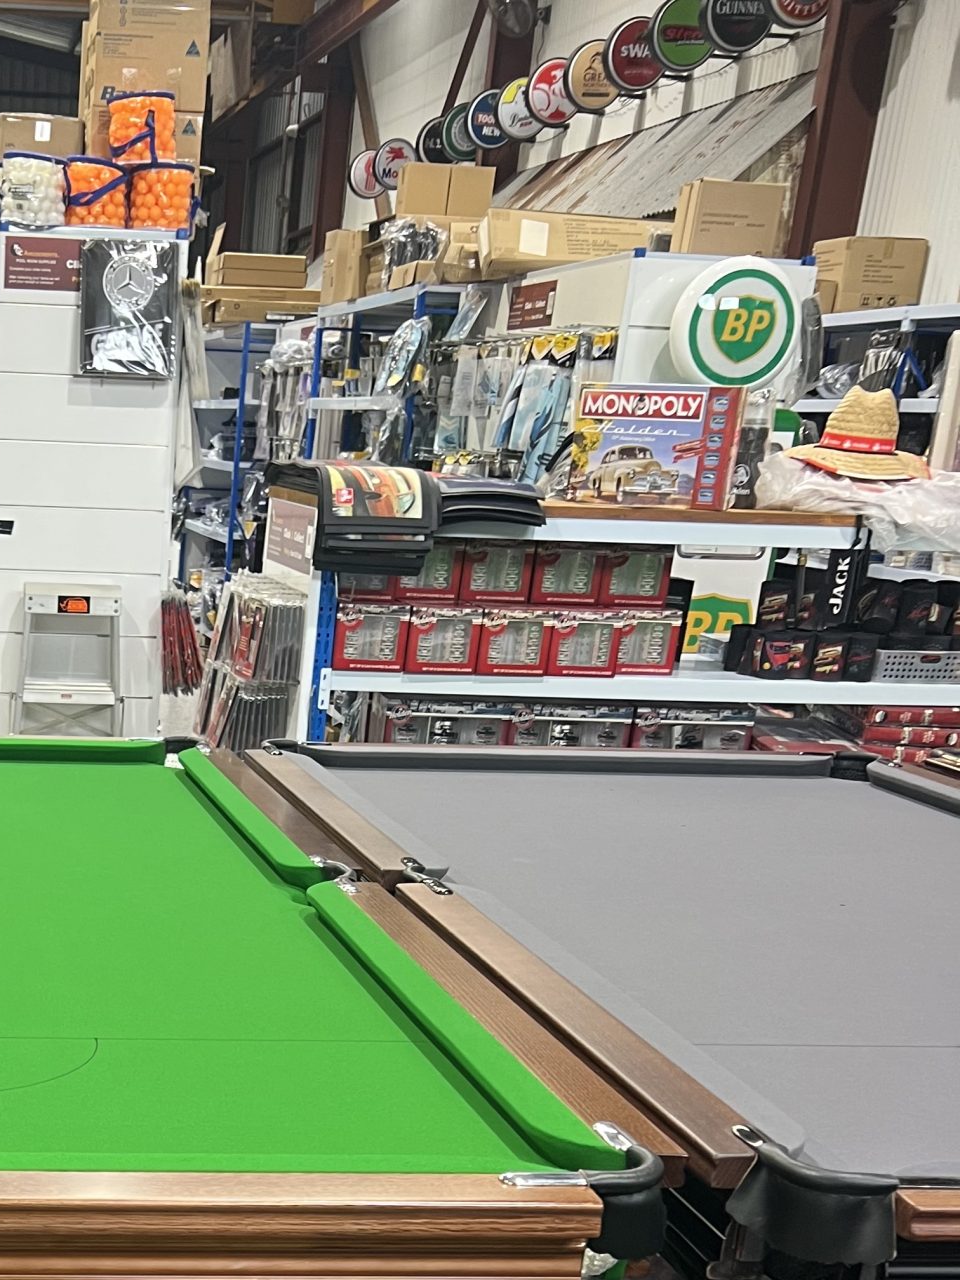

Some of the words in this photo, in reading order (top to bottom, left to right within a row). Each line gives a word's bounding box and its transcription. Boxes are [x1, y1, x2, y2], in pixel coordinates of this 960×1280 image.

[620, 43, 651, 58] SWA
[720, 308, 770, 342] BP
[584, 393, 702, 417] MONOPOLY
[581, 420, 691, 437] Holden
[828, 556, 851, 615] JACK
